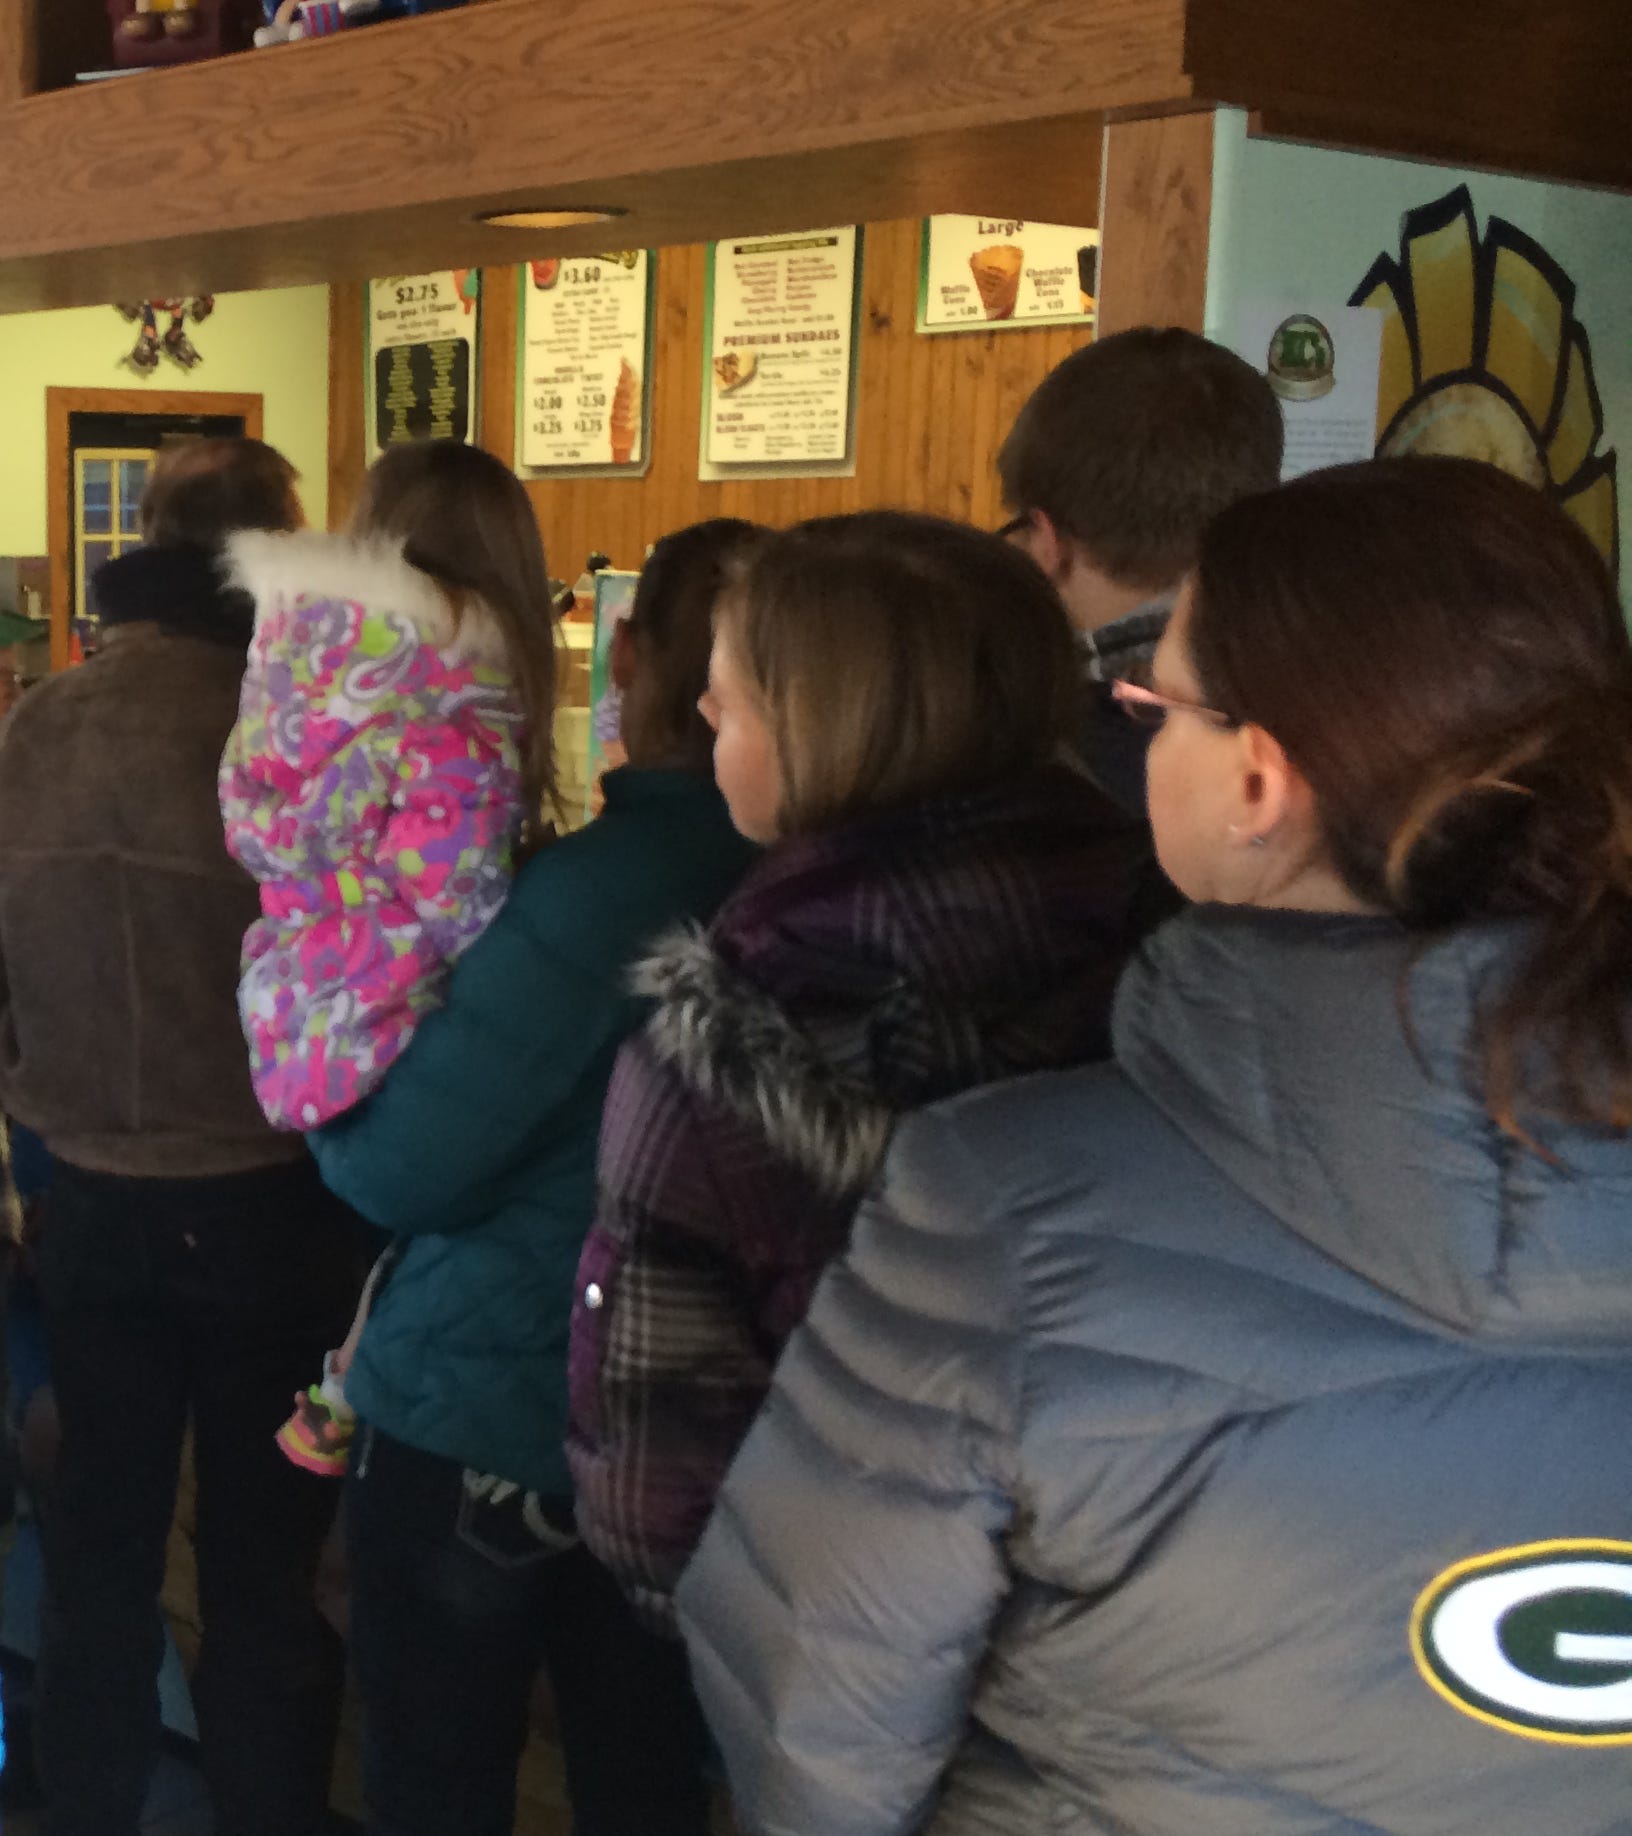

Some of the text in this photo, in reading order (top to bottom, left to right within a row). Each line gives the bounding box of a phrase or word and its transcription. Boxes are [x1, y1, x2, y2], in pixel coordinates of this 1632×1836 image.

[977, 219, 1024, 236] Large
[1025, 266, 1073, 278] Chocolate
[396, 283, 439, 305] $2.75
[723, 329, 841, 347] PREMIUM SUNDAES
[1418, 1547, 1632, 1735] G
